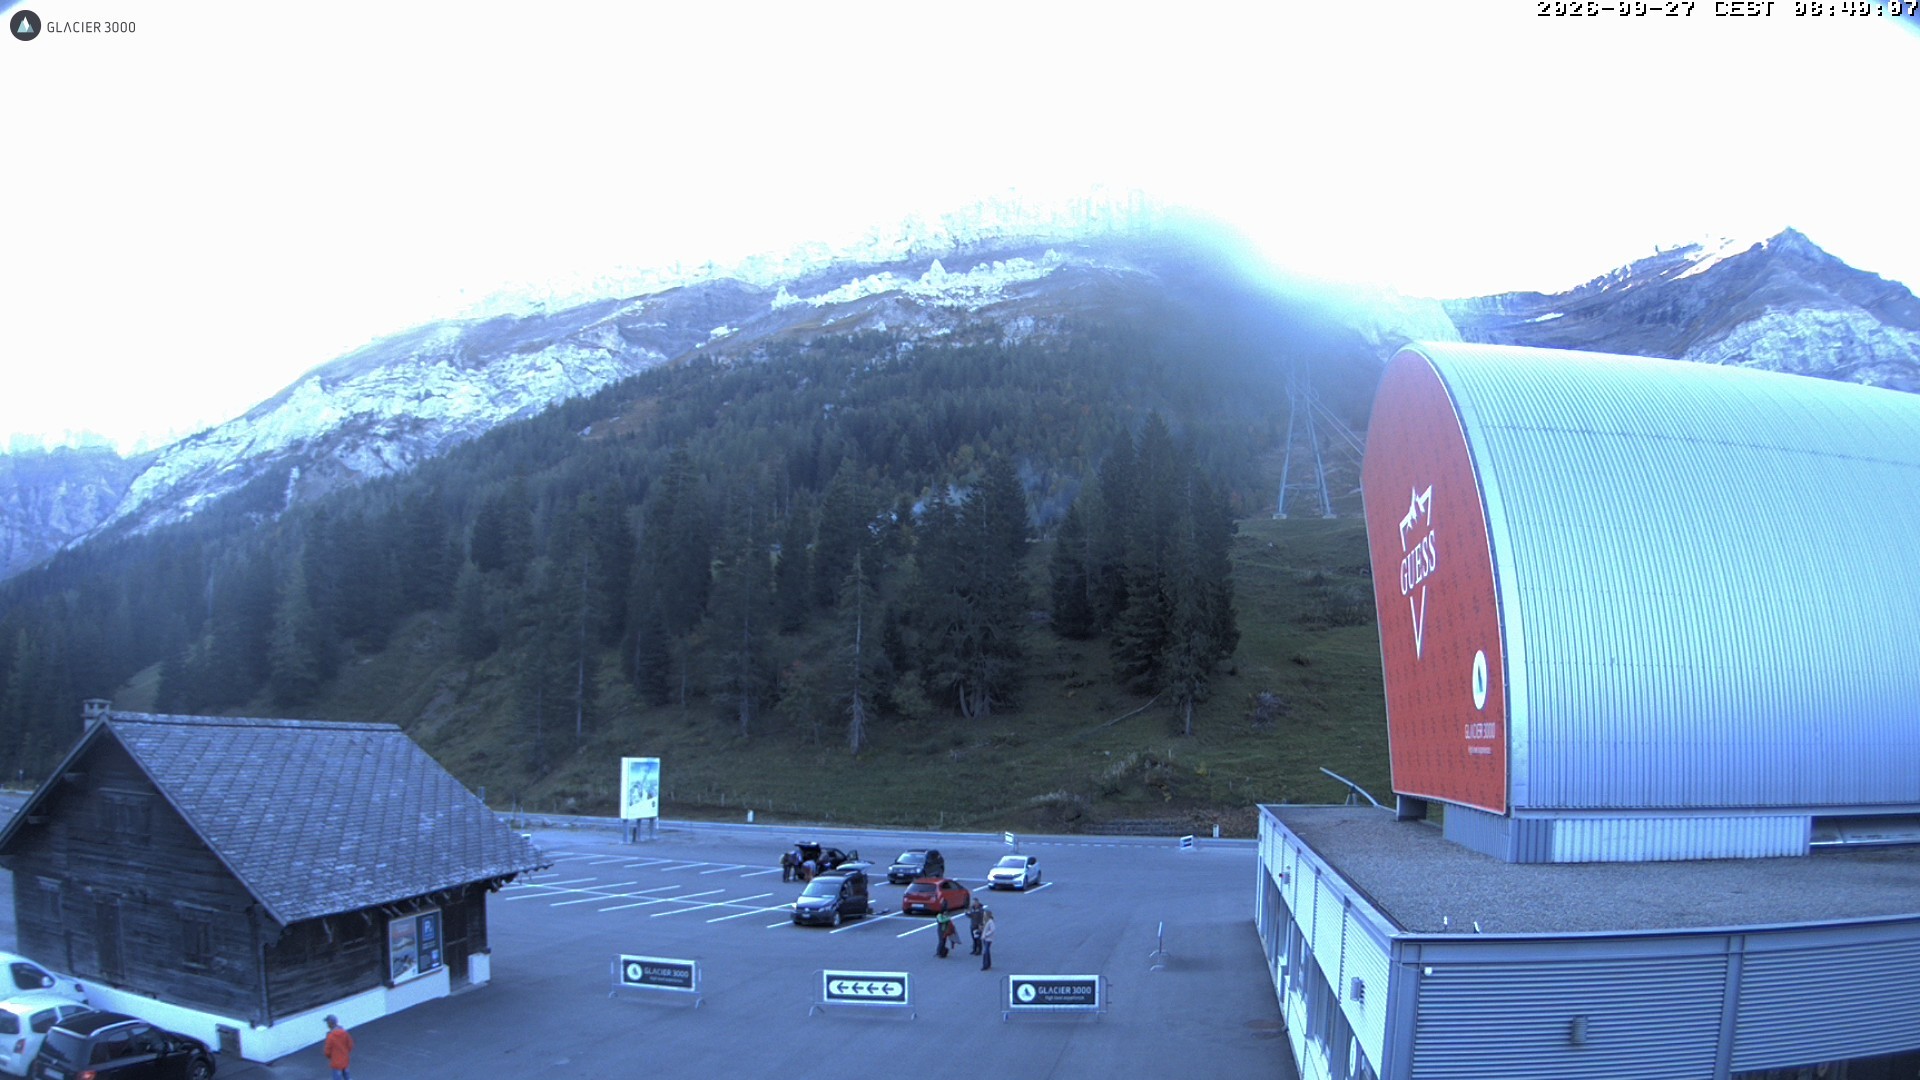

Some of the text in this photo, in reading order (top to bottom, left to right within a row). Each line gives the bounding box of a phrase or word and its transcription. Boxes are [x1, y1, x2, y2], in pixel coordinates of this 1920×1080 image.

[1400, 530, 1436, 595] GUESS
[644, 966, 689, 978] GLACIER 3000
[1038, 986, 1092, 995] GLACIER 3000
